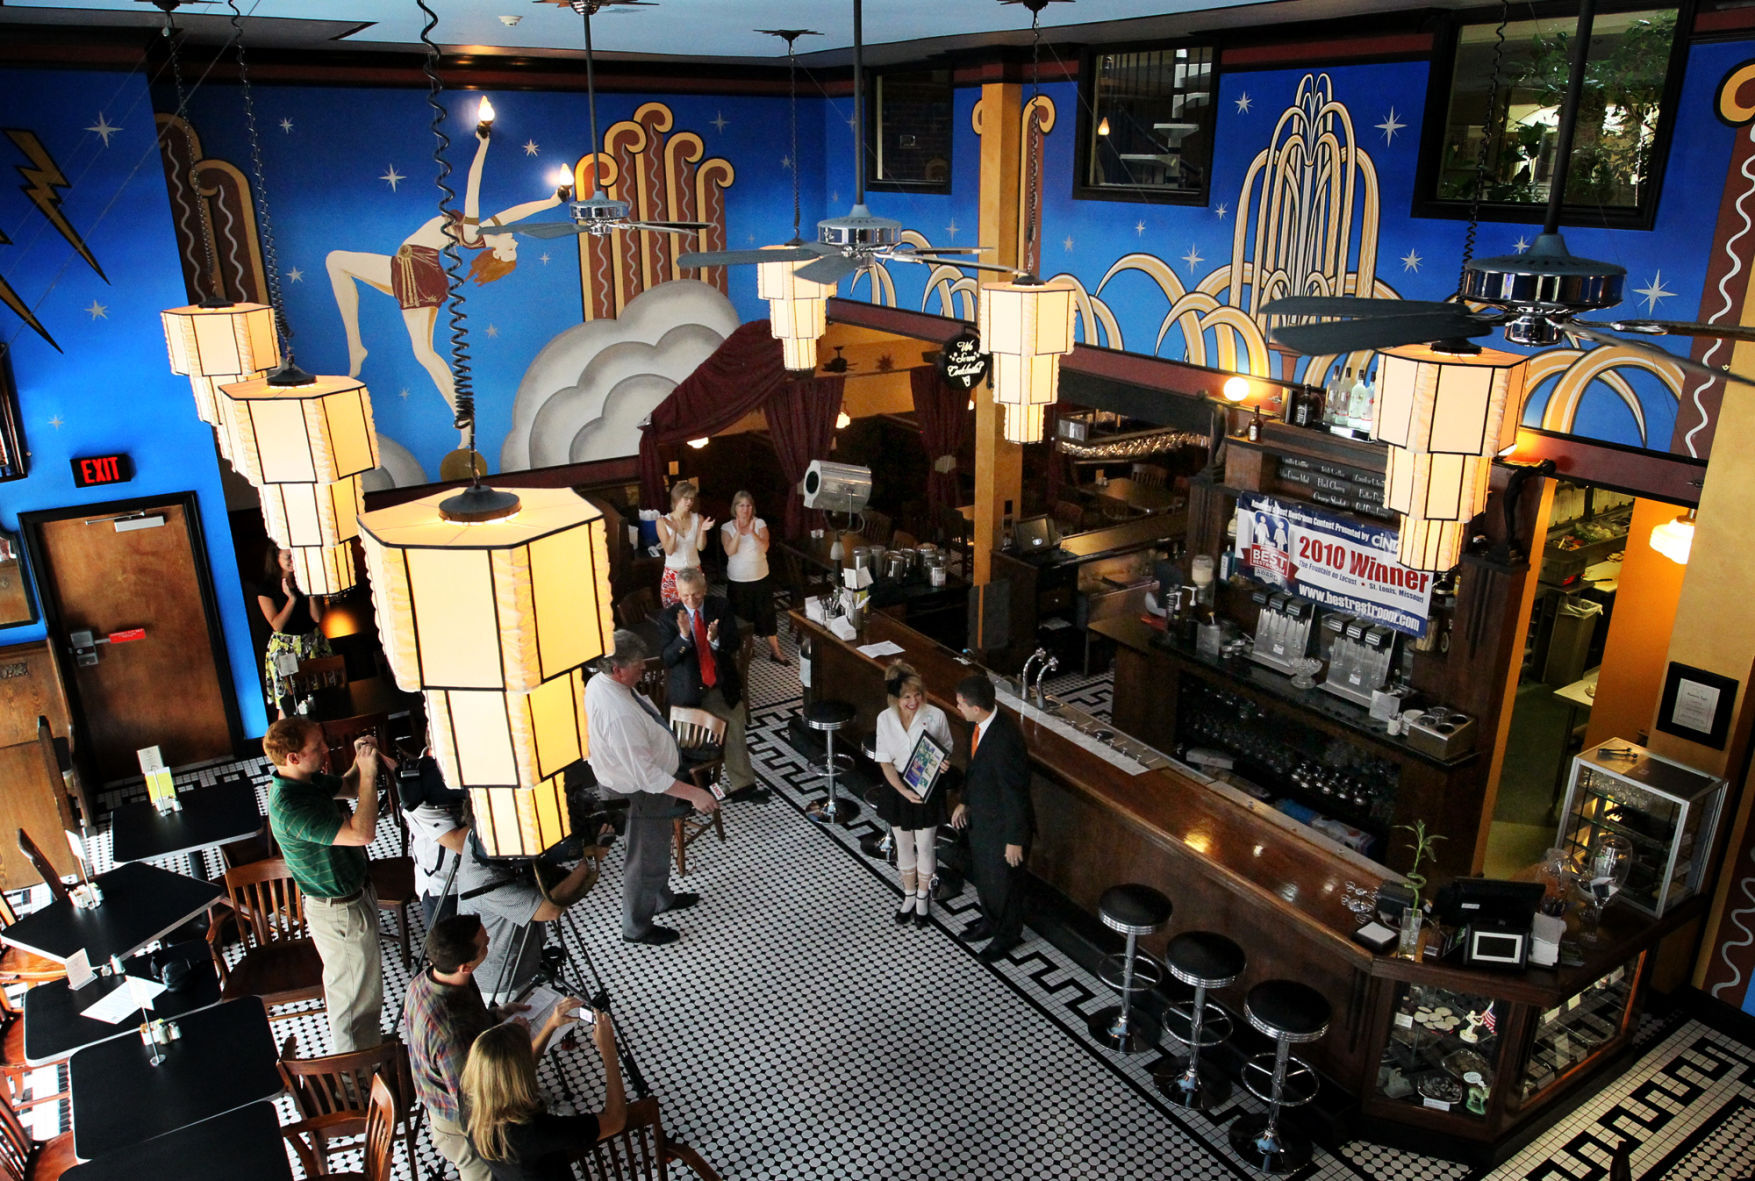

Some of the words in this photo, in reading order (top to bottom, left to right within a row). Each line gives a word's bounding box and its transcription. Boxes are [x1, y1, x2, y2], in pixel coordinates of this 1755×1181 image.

[80, 456, 120, 484] EXIT
[1313, 517, 1335, 530] Contest
[1335, 522, 1361, 540] Presented
[1361, 532, 1370, 542] by
[1252, 549, 1288, 568] BEST
[1299, 535, 1346, 570] 2010
[1349, 550, 1430, 593] Winner
[1298, 560, 1308, 569] The
[1308, 563, 1331, 577] Fountain
[1331, 571, 1339, 579] on
[1340, 573, 1357, 585] Locust
[1298, 583, 1420, 632] www.bestrestroom.com
